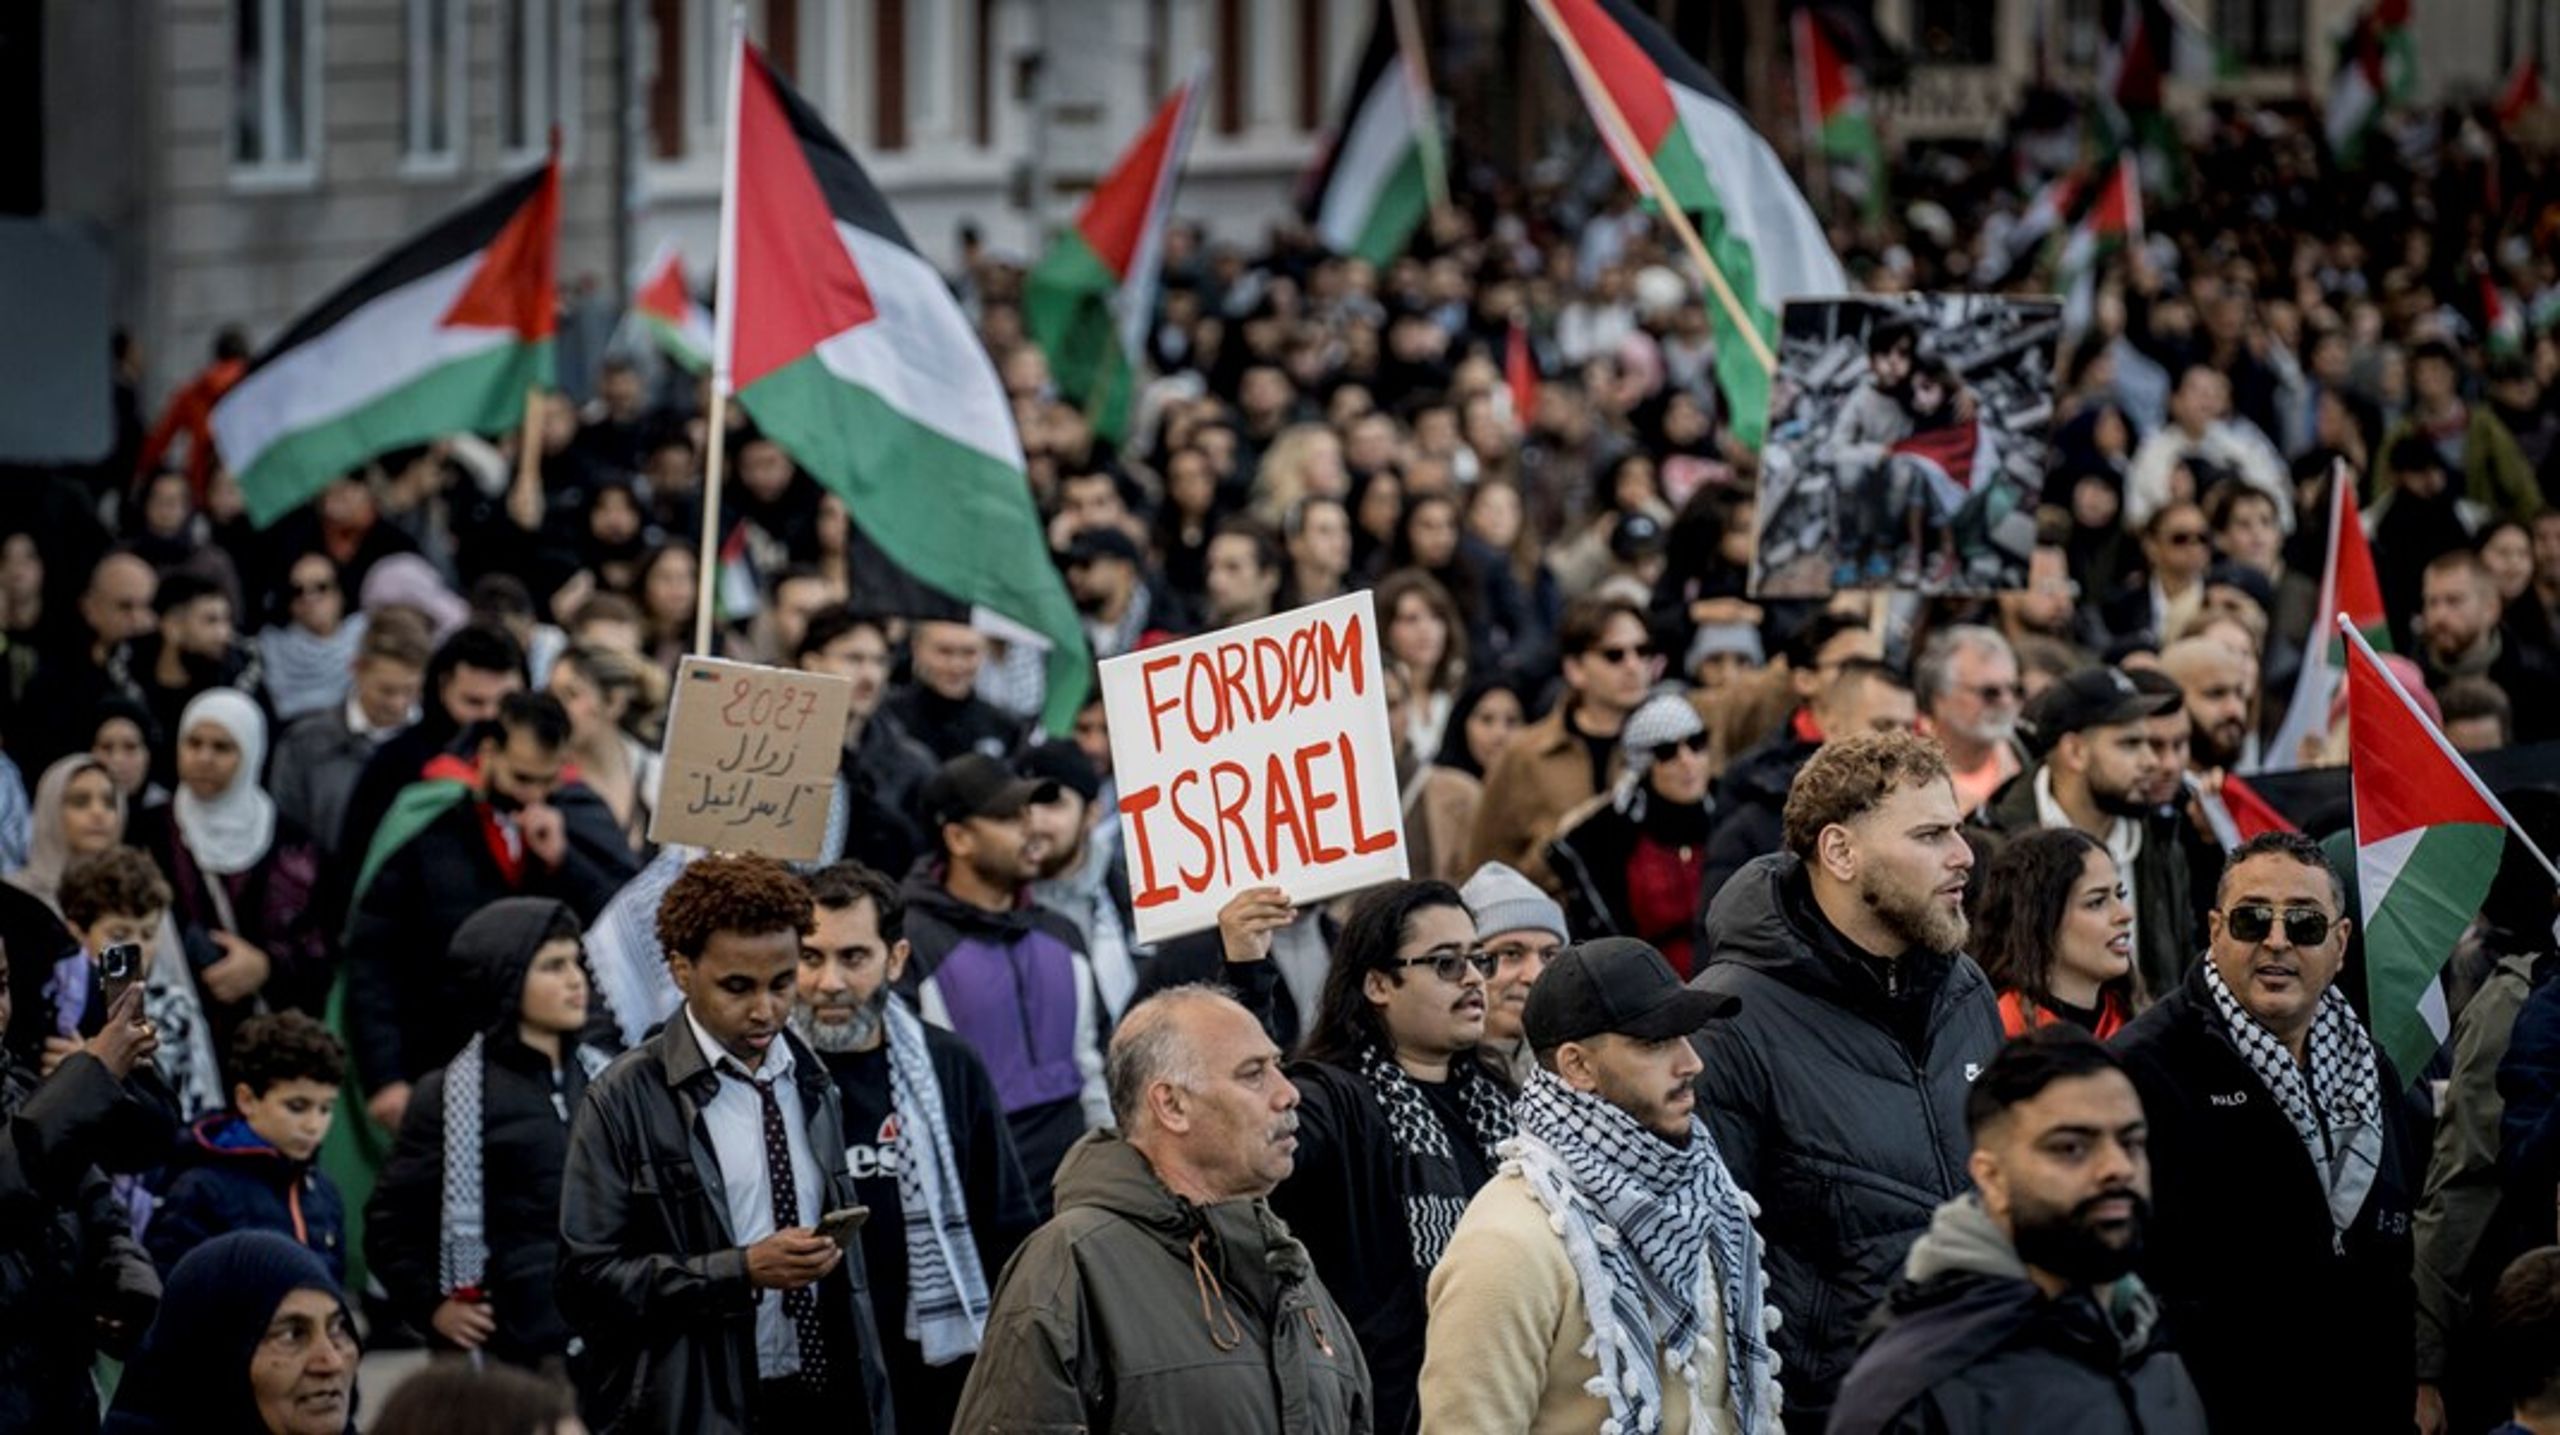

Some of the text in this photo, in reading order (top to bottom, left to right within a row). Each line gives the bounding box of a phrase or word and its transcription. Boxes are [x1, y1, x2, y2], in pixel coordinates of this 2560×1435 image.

[722, 678, 817, 731] 2027
[1142, 613, 1364, 753] FORDØM
[717, 732, 798, 776] زوال
[1119, 731, 1398, 908] ISRAEL
